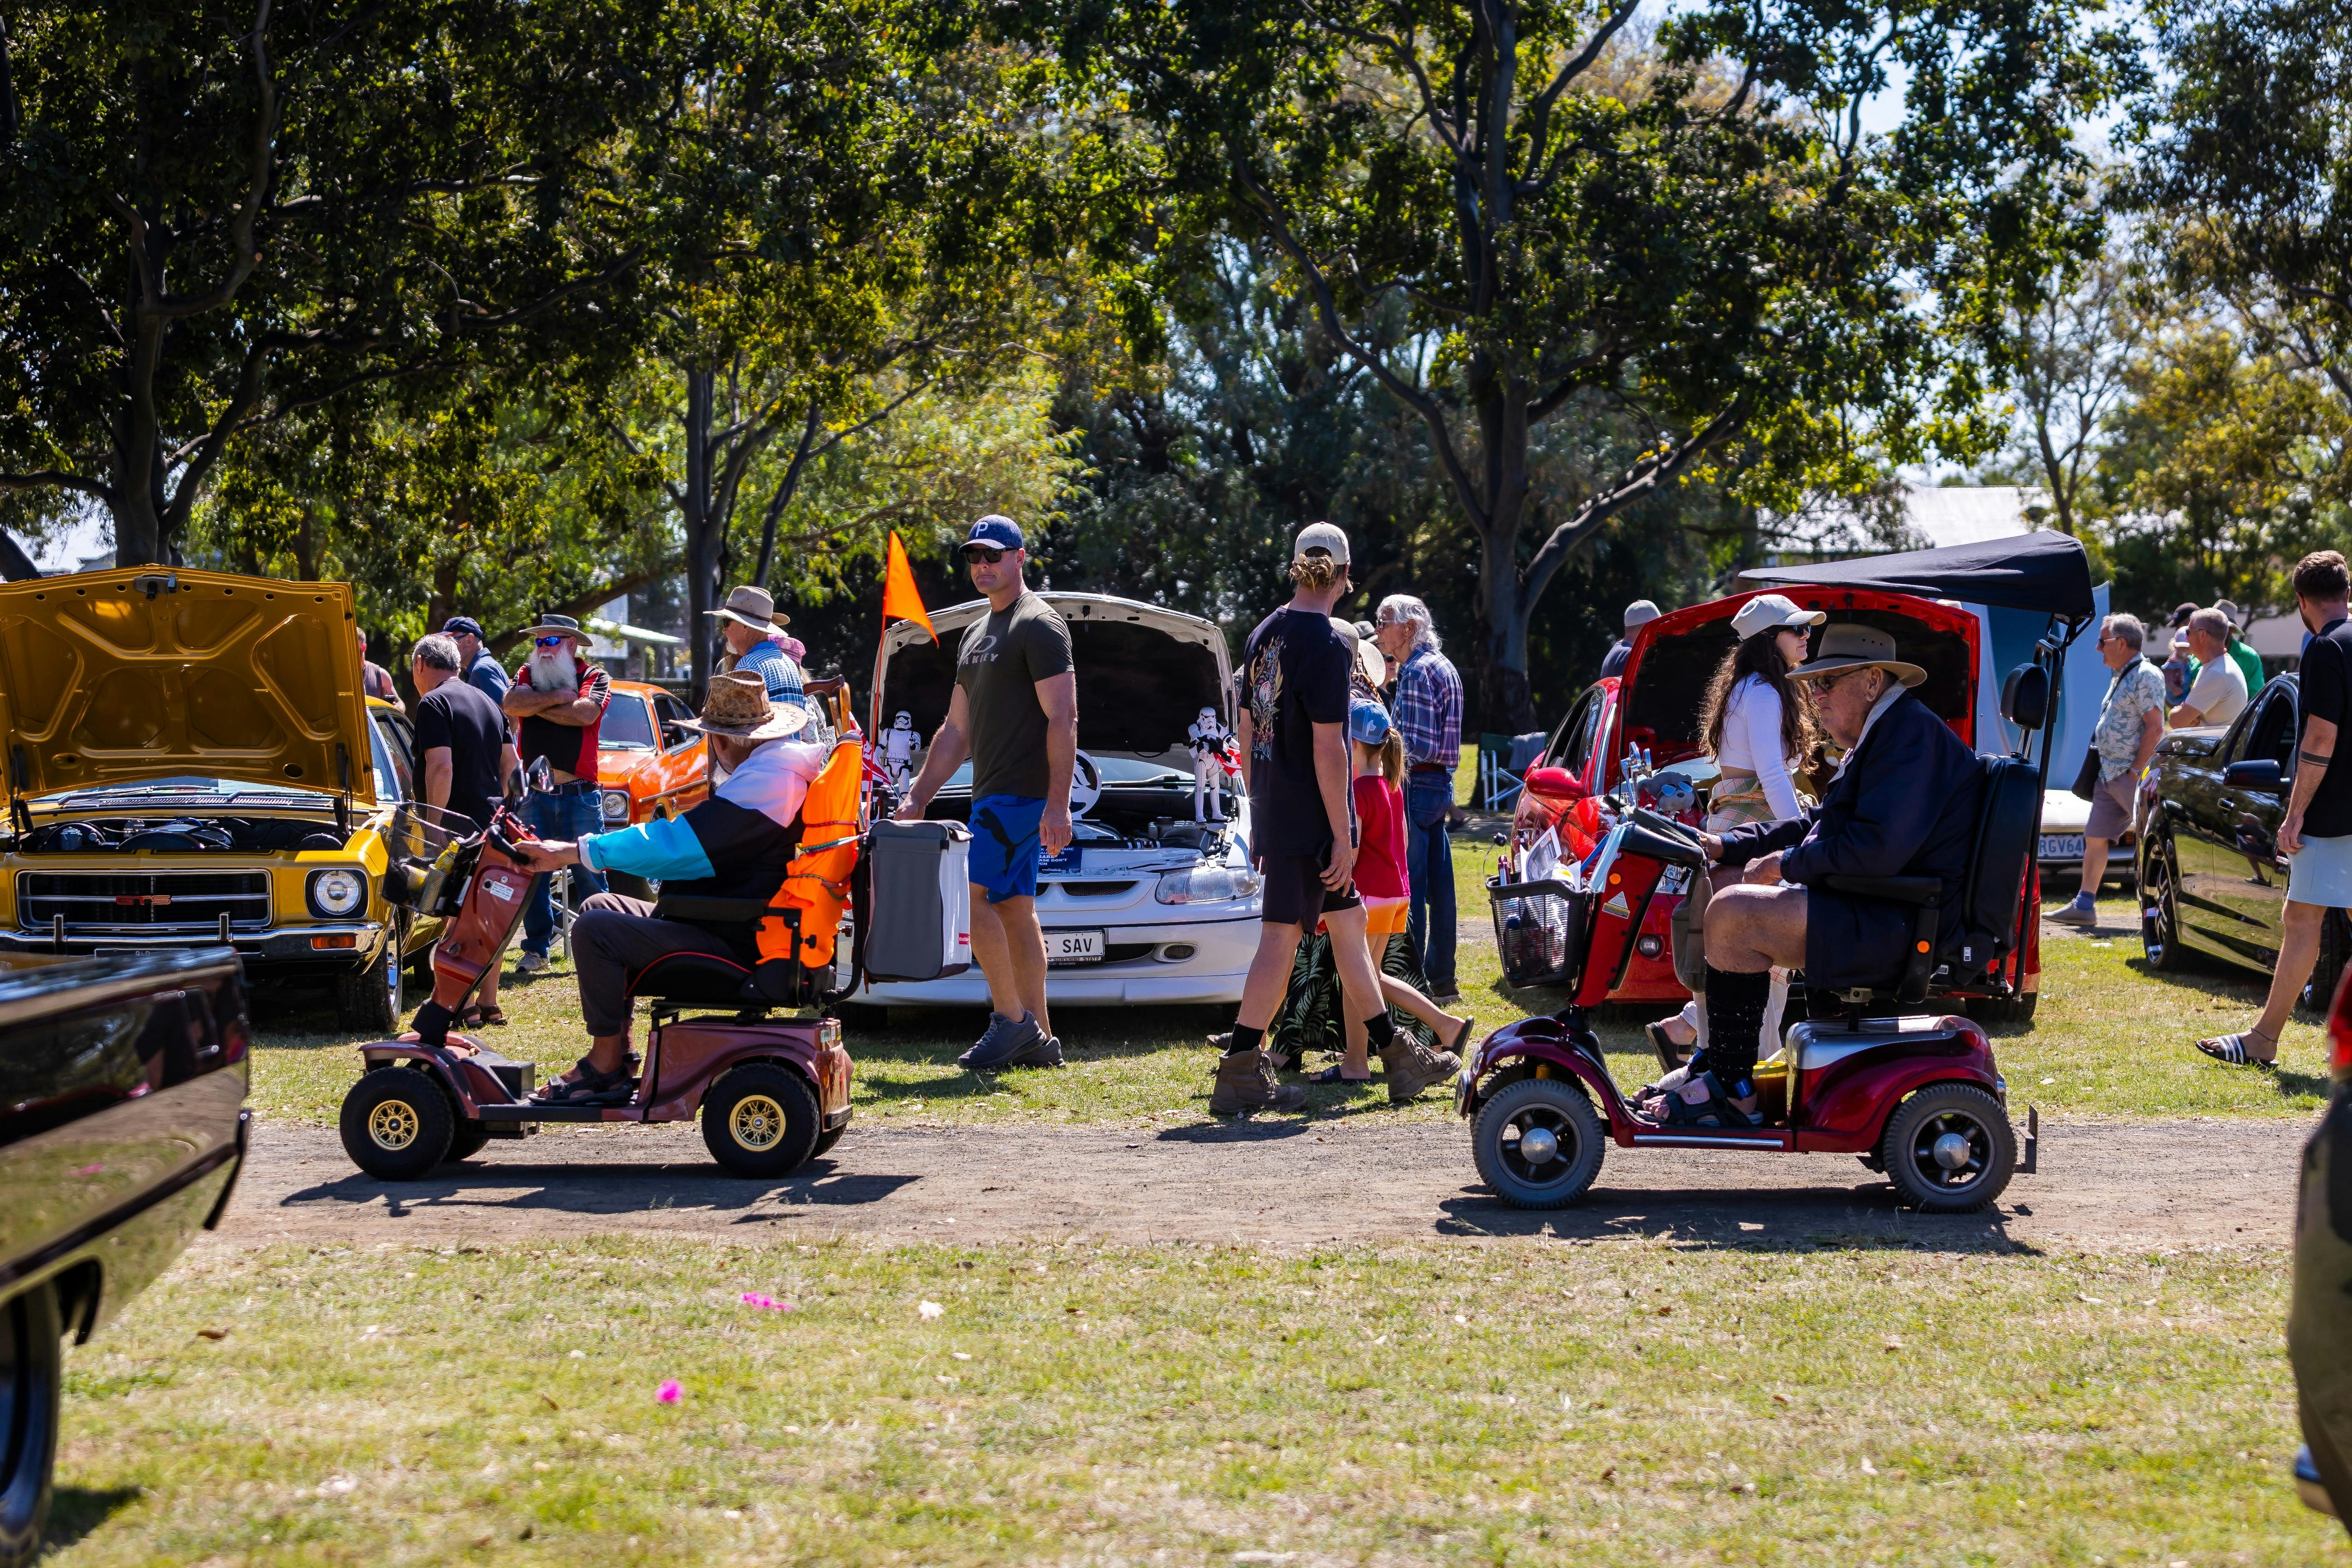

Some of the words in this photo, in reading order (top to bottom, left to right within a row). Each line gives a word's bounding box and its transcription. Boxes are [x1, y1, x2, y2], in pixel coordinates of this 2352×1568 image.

[975, 522, 989, 538] P
[115, 895, 171, 905] GTS
[1063, 938, 1092, 953] SAV
